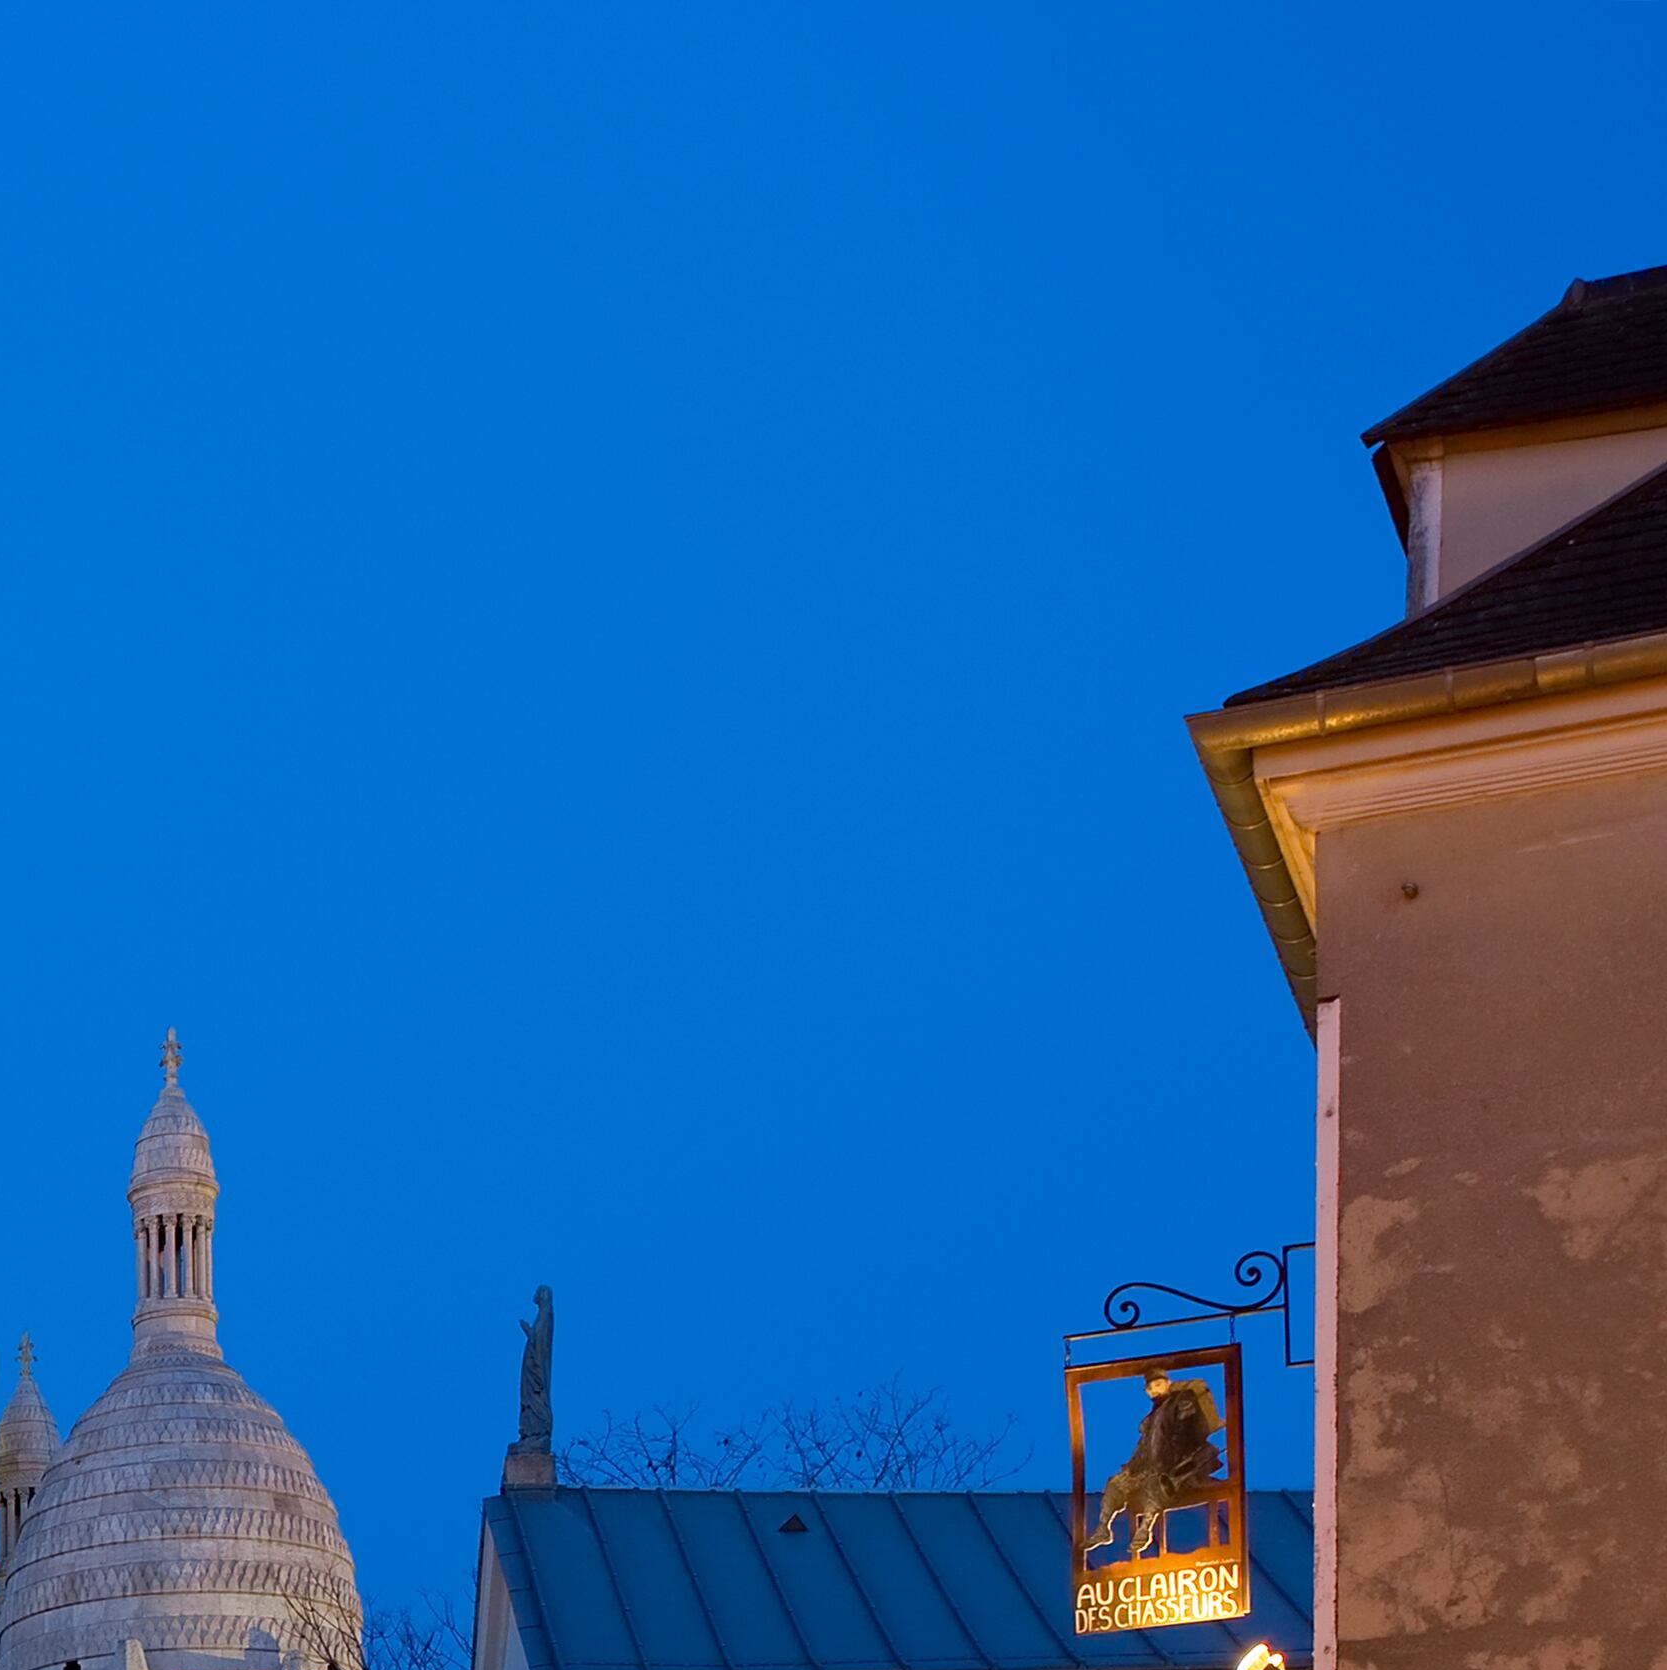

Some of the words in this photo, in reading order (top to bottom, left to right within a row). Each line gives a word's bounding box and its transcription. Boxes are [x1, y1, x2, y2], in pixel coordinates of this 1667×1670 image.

[1077, 1580, 1114, 1608] AU
[1117, 1564, 1239, 1603] CLAIRON
[1075, 1606, 1113, 1634] DES
[1114, 1589, 1238, 1628] CHASSEURS
